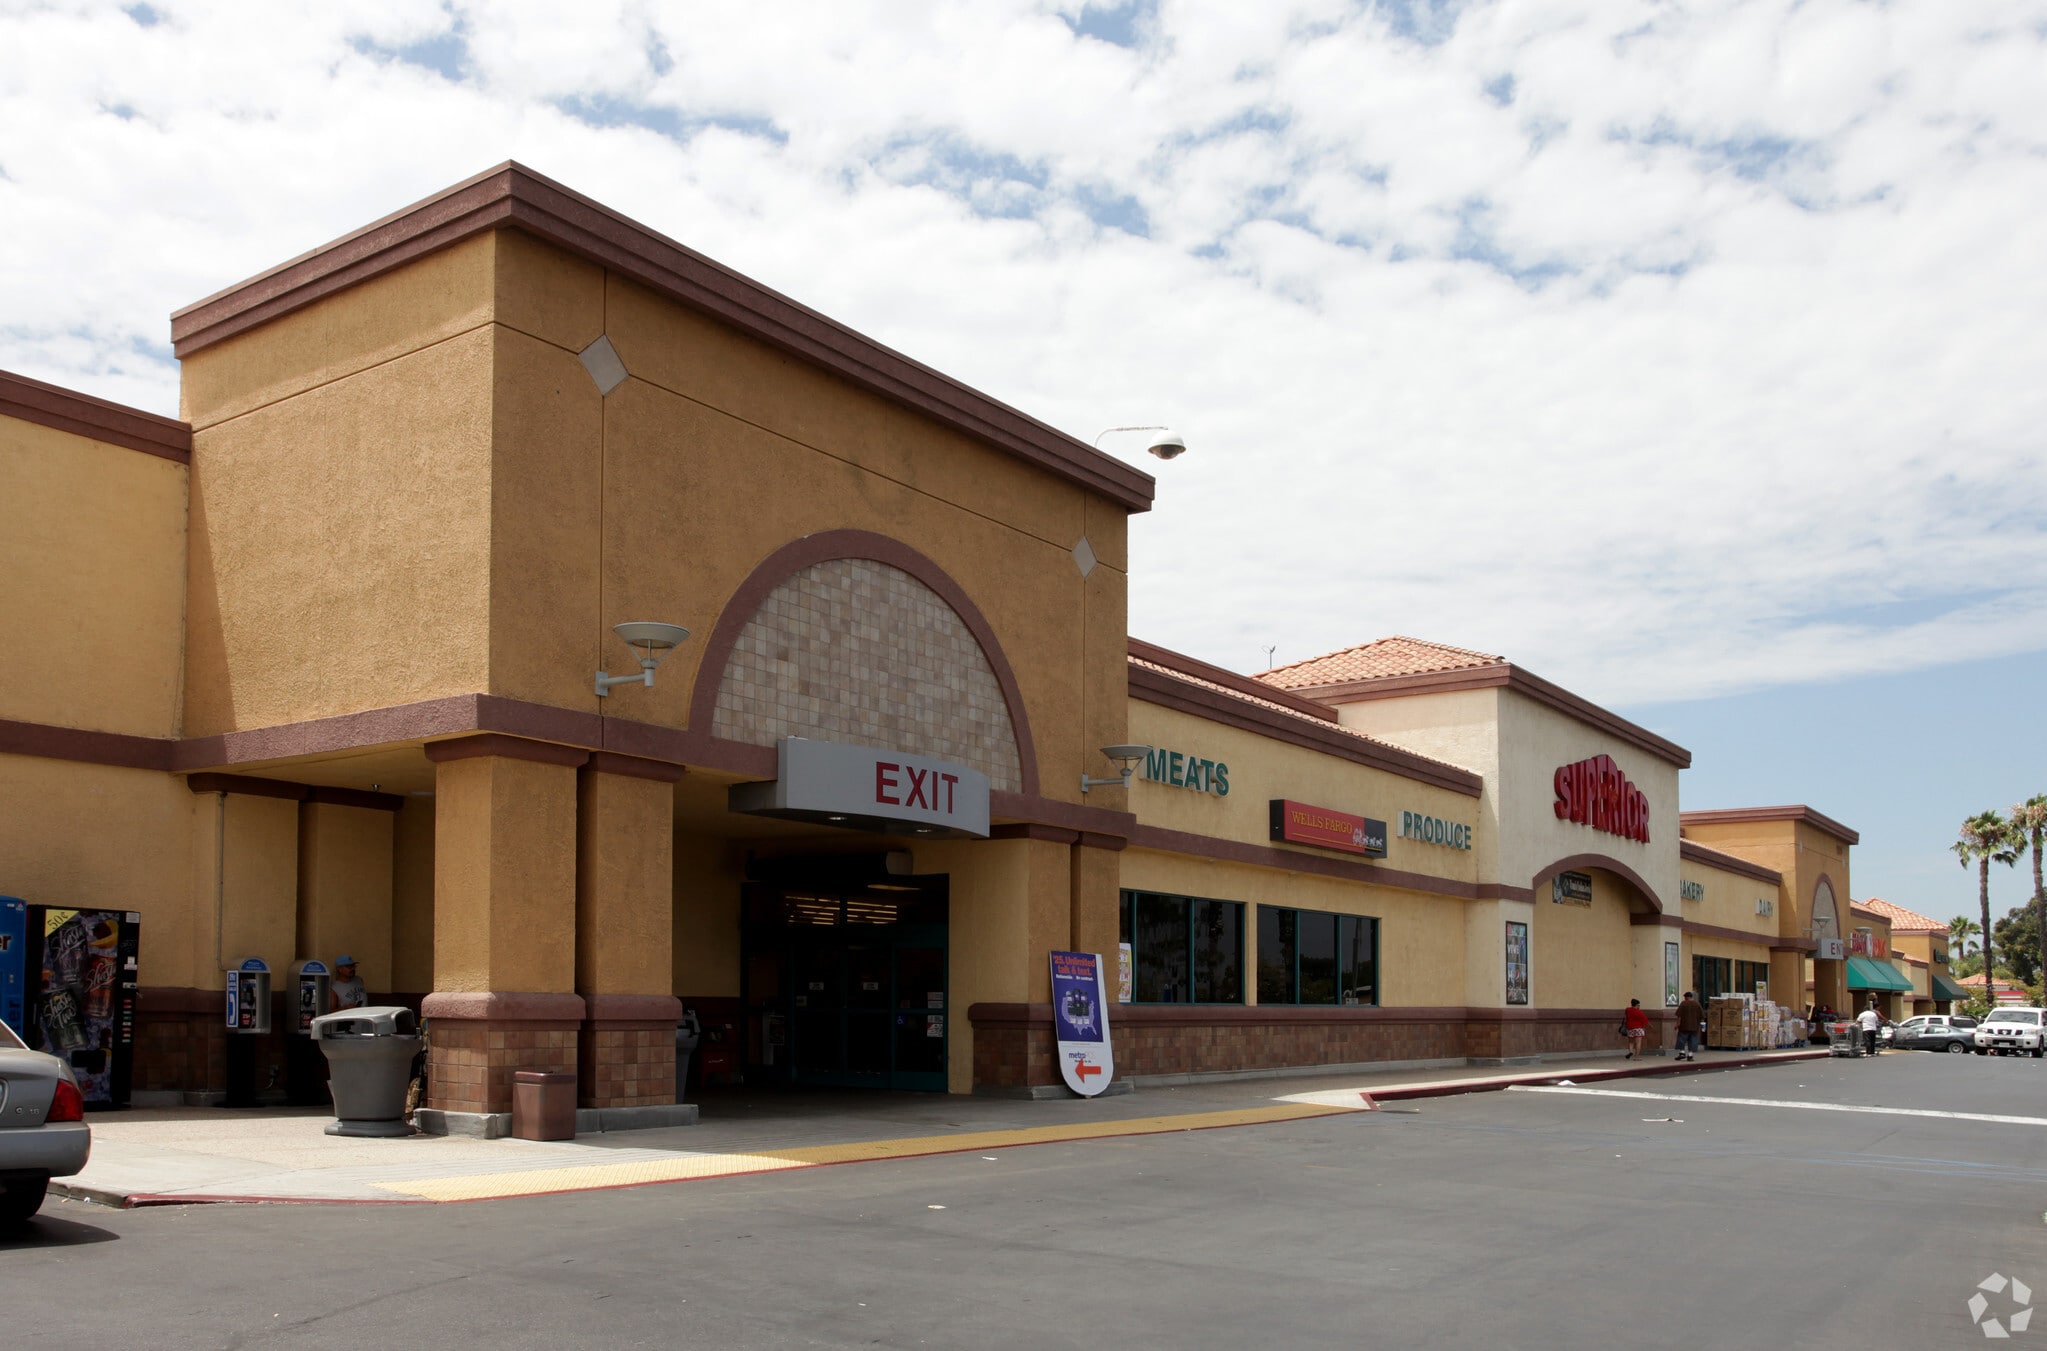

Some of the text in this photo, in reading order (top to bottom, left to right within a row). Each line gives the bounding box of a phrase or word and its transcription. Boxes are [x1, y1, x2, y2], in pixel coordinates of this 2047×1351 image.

[876, 762, 959, 814] EXIT
[1144, 749, 1229, 796] MEATS
[1553, 754, 1650, 843] SUPERIOR
[1291, 811, 1353, 835] WELLS FARGO
[1402, 811, 1472, 850] PRODUCE
[47, 911, 69, 931] 50¢
[1757, 898, 1775, 917] DARY
